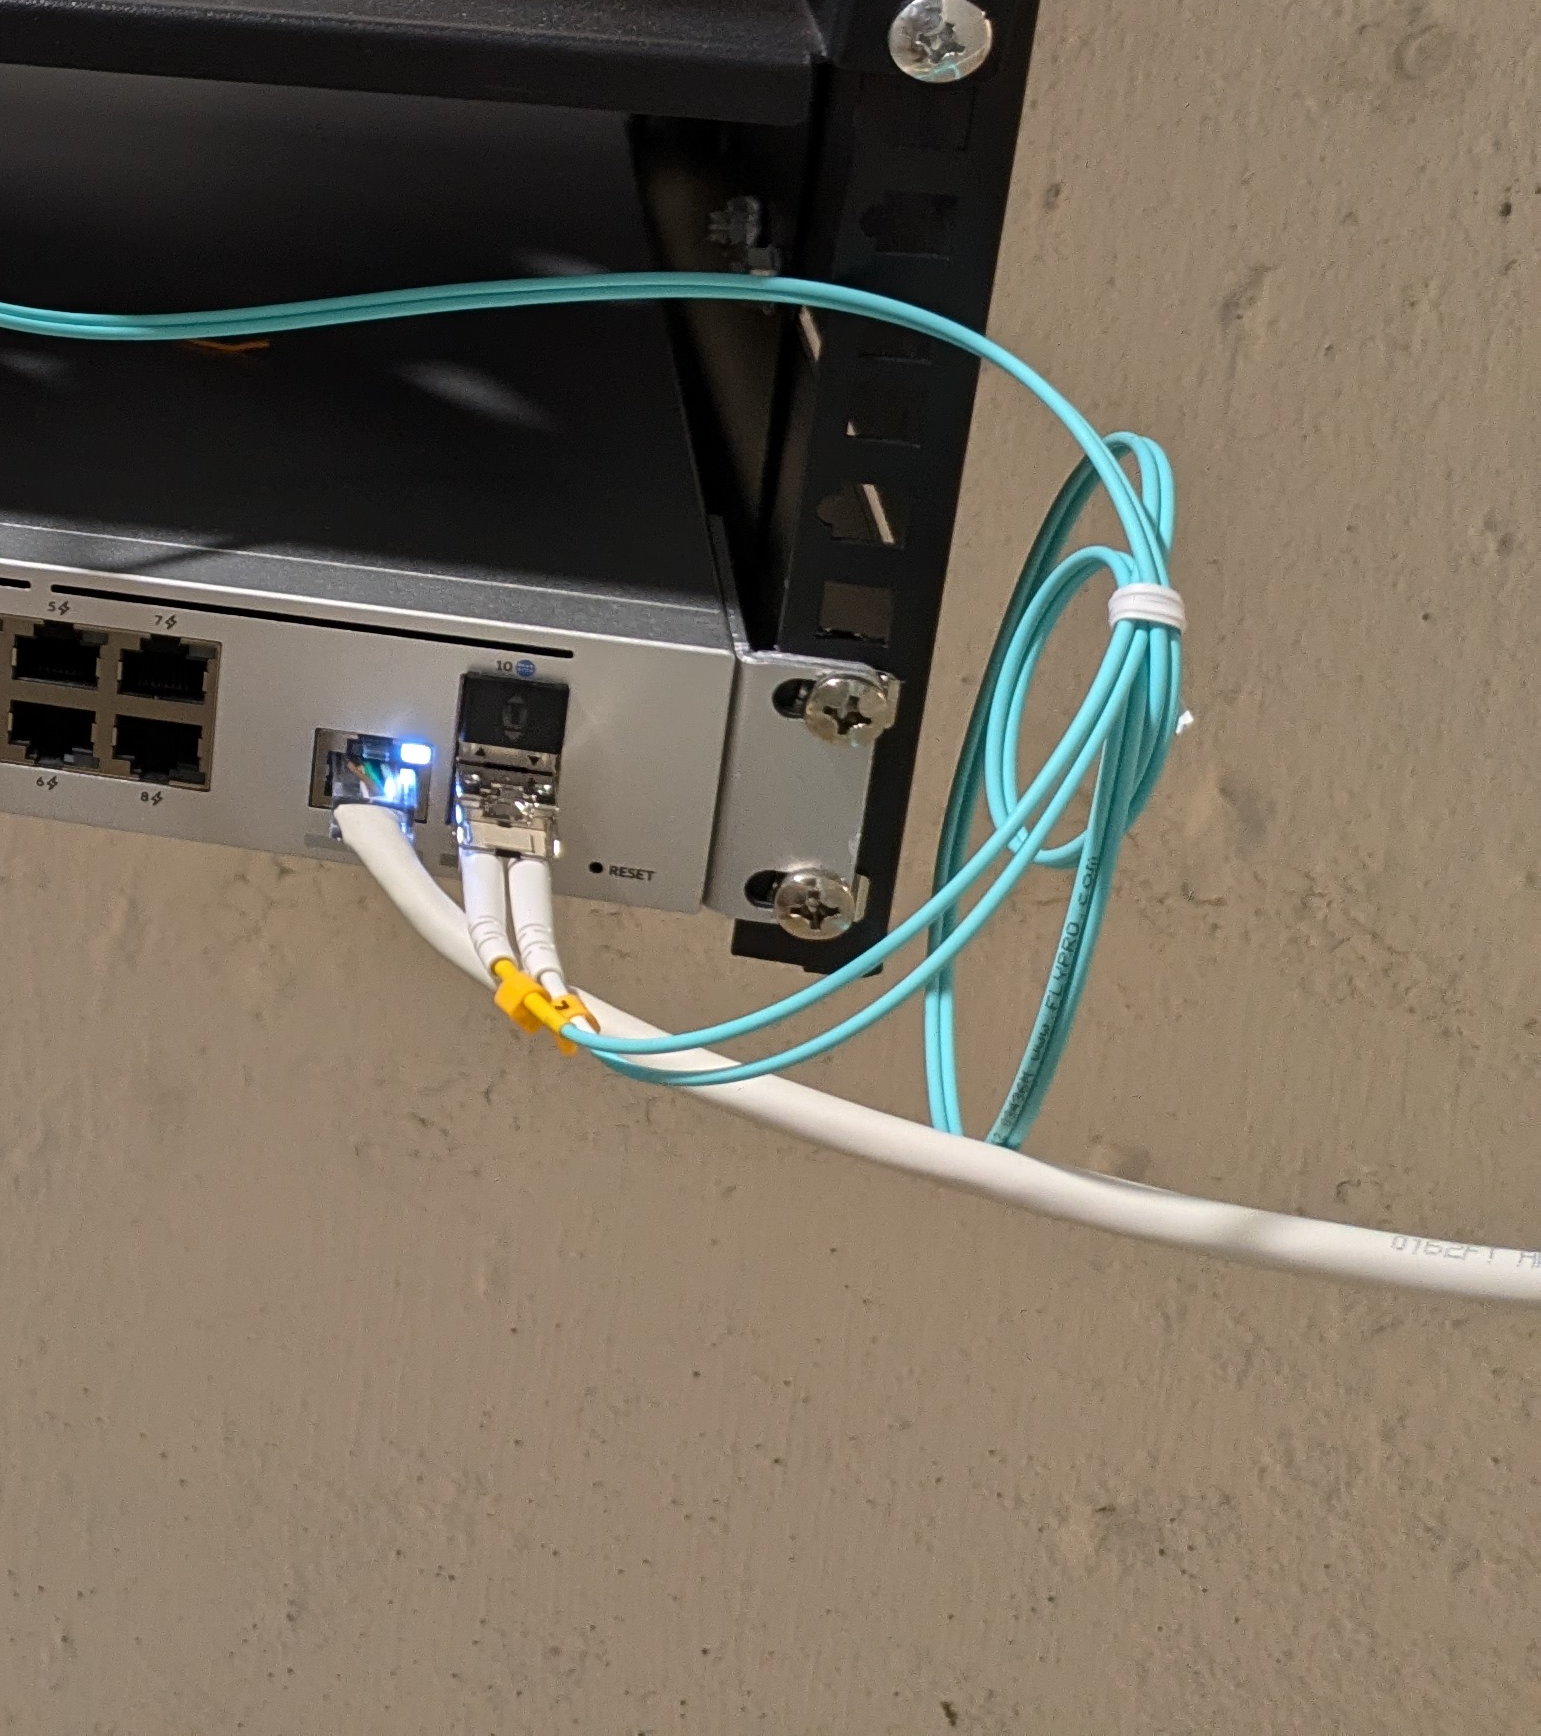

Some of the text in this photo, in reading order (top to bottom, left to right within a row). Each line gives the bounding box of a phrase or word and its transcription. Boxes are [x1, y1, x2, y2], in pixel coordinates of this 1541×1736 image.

[48, 601, 56, 612] 5
[154, 615, 163, 626] 7
[495, 660, 513, 672] 10
[36, 776, 45, 788] 6
[140, 791, 149, 802] 8
[608, 865, 656, 881] RESET
